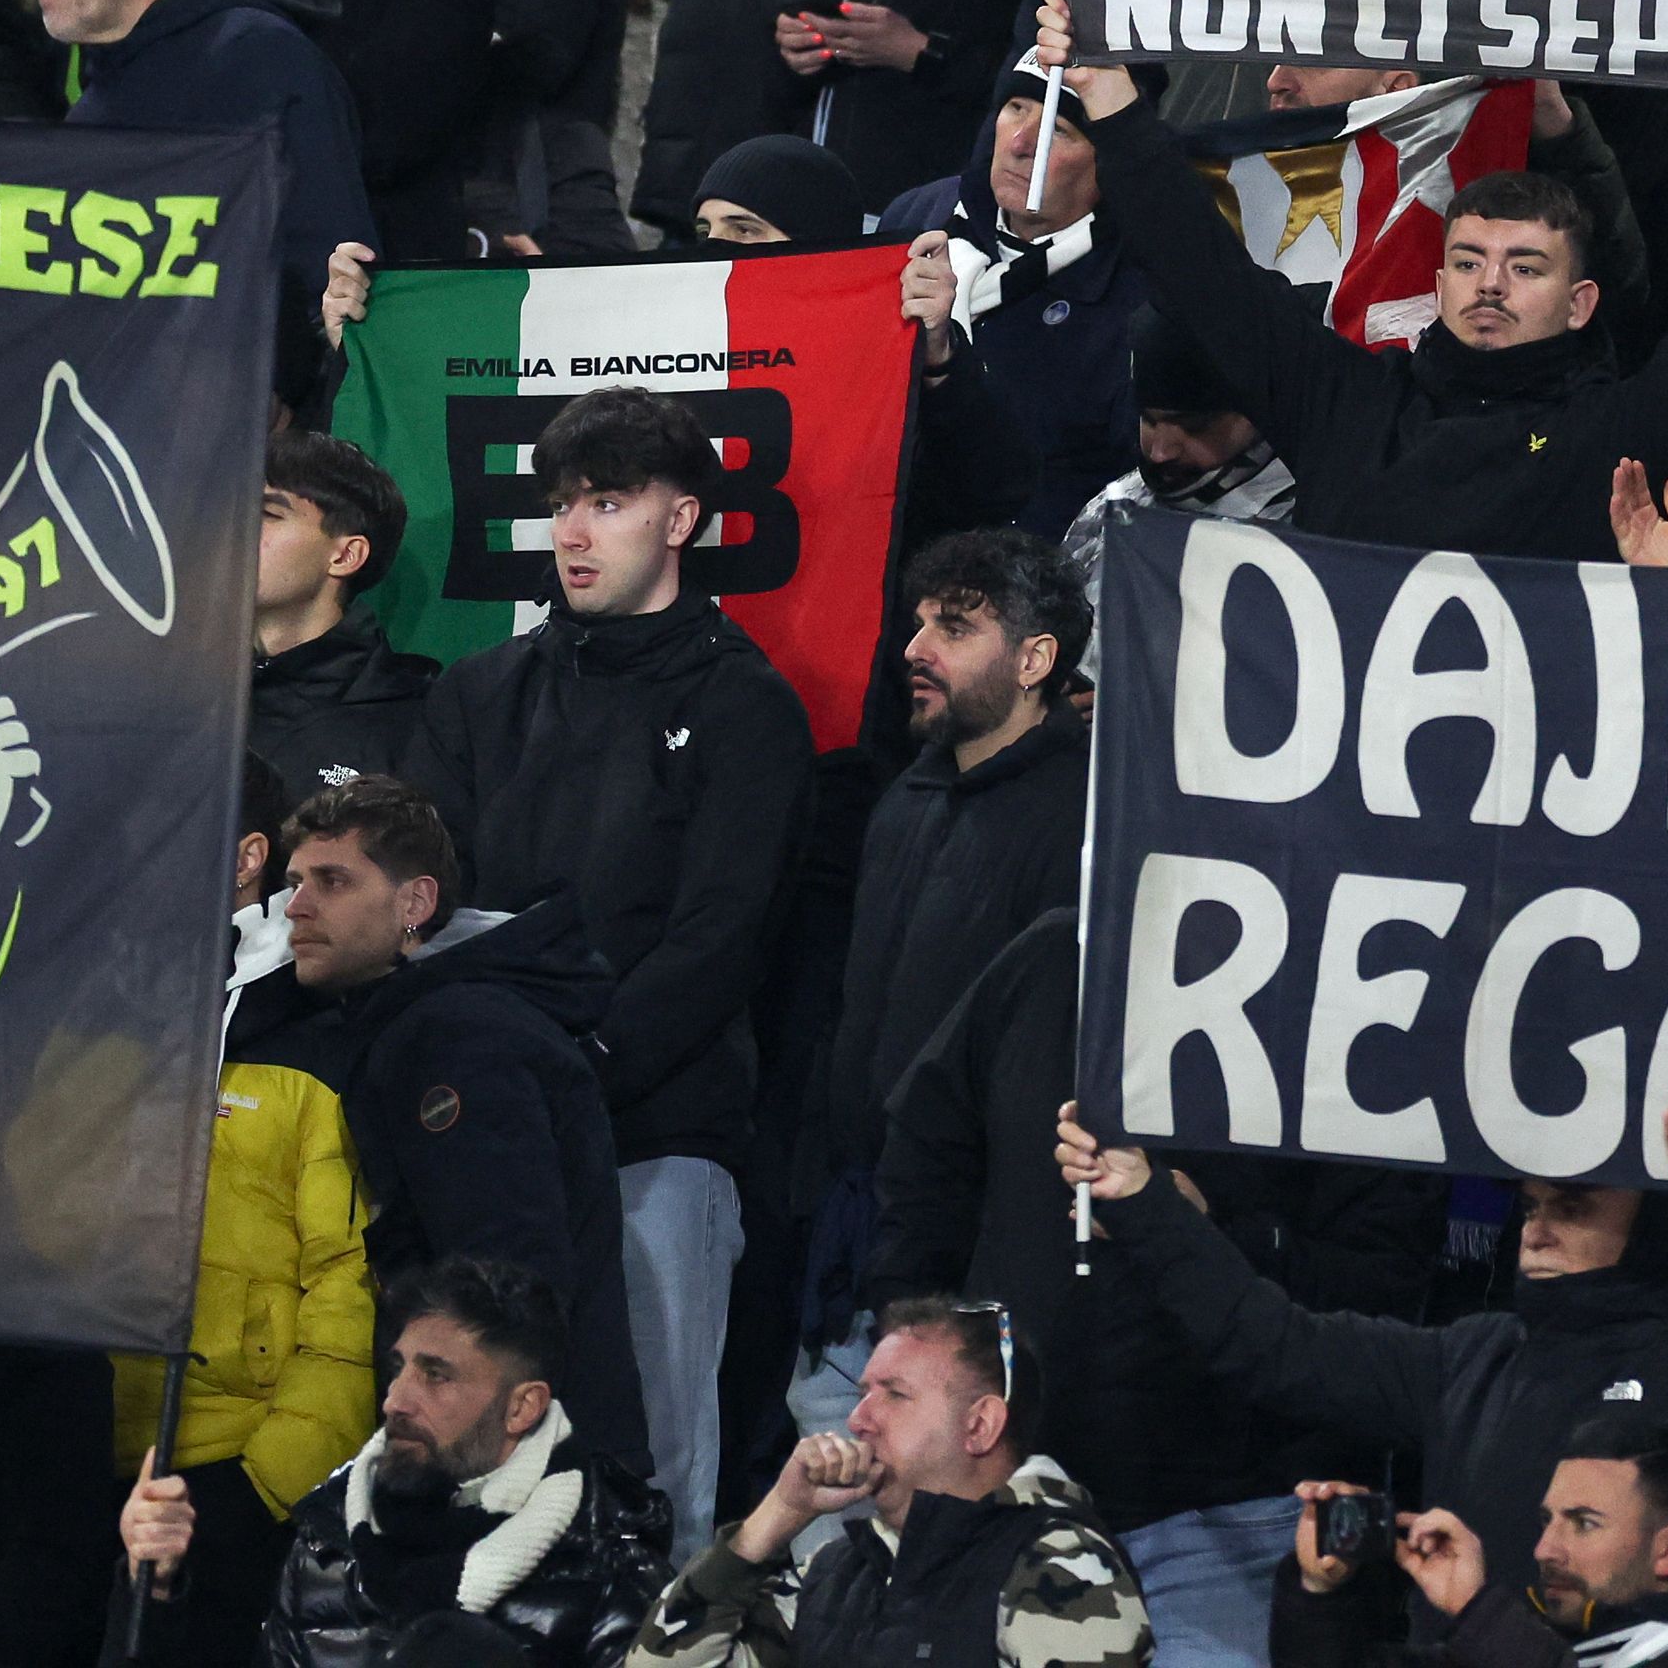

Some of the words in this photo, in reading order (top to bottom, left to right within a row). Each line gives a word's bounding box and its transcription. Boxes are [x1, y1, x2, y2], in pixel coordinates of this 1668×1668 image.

[445, 355, 556, 378] EMILIA
[569, 346, 796, 378] BIANCONERA
[333, 763, 350, 774] THE
